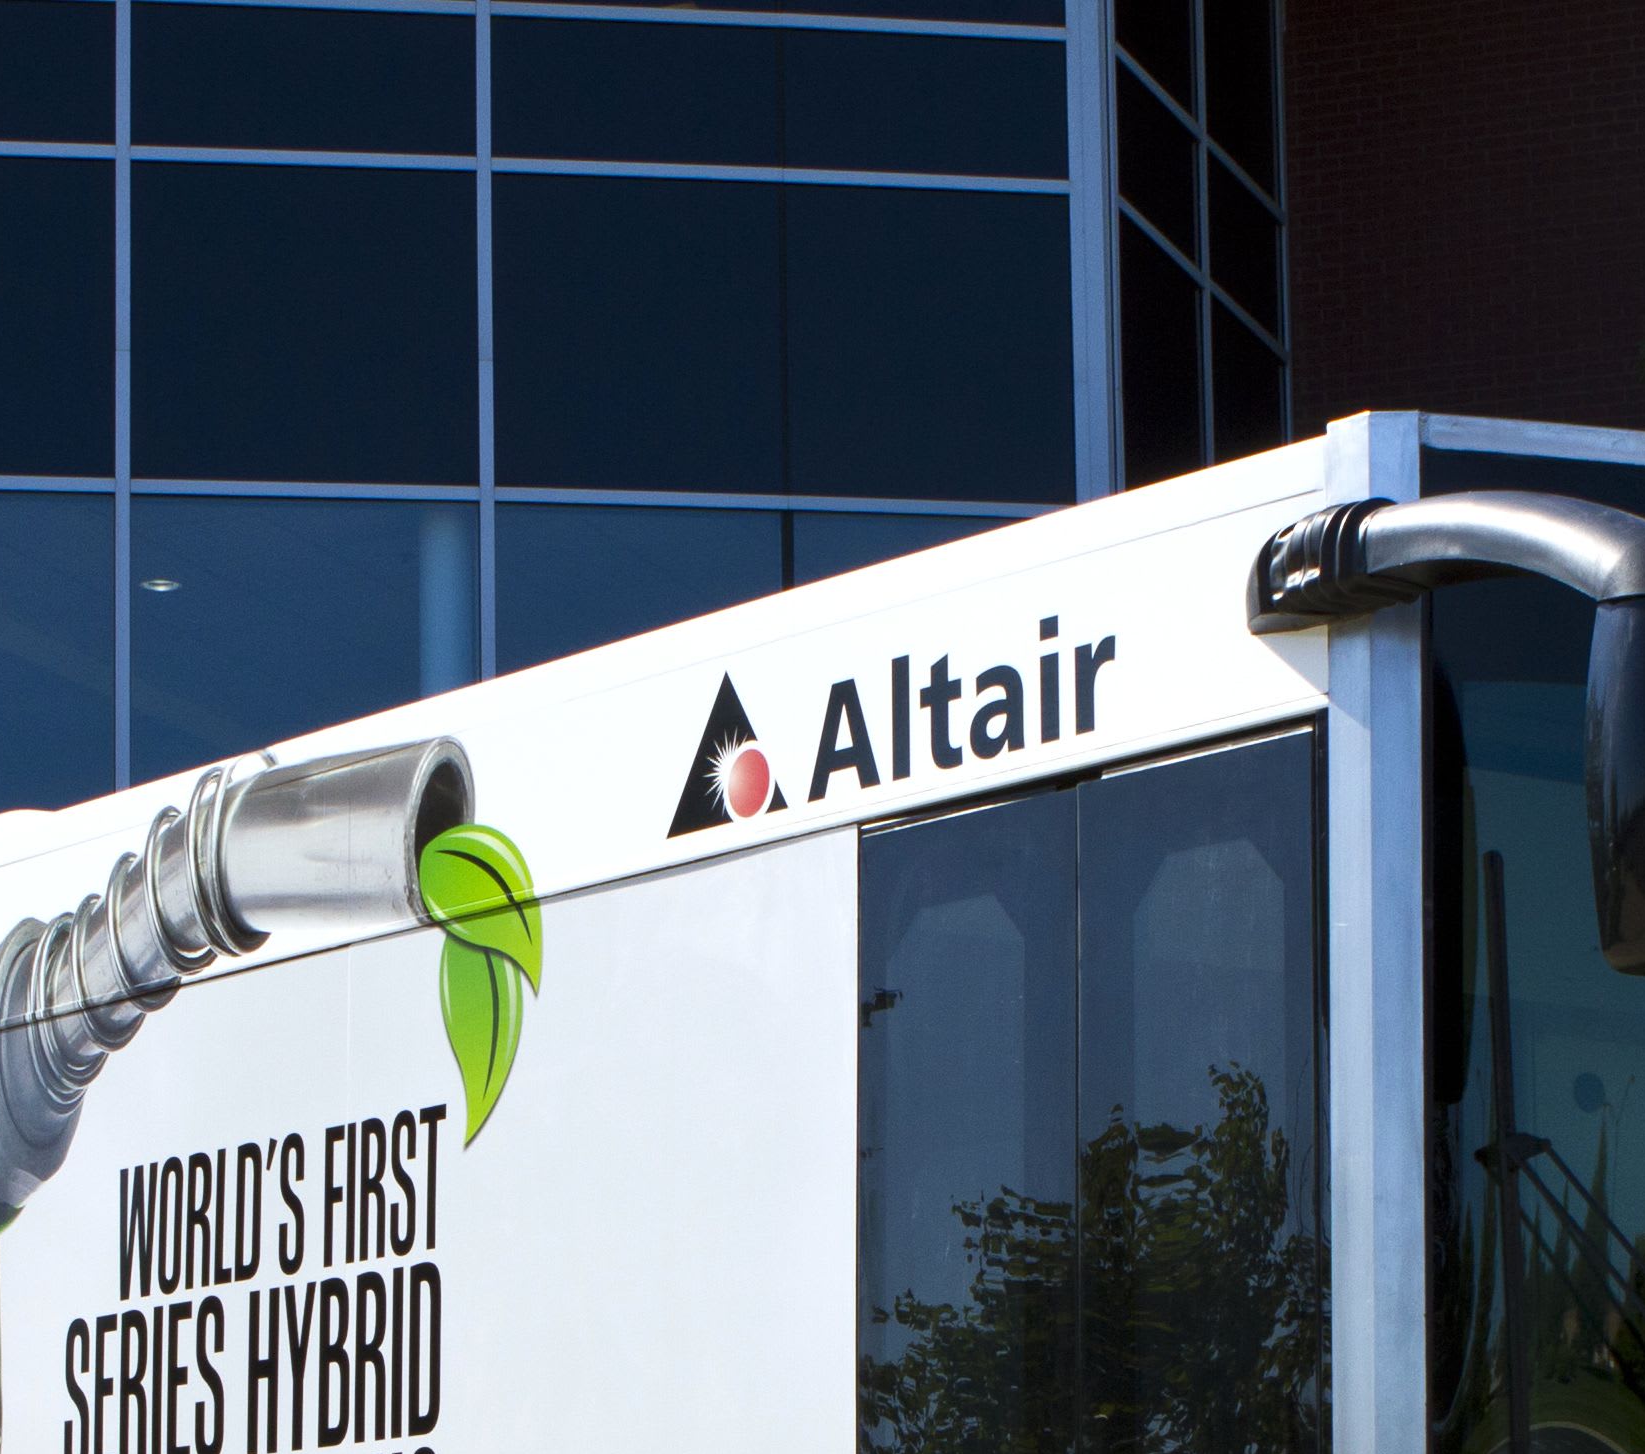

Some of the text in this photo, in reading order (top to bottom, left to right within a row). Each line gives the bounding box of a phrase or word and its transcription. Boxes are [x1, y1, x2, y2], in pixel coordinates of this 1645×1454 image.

[807, 614, 1116, 803] Altair
[119, 1103, 447, 1302] WORLD'S FIRST
